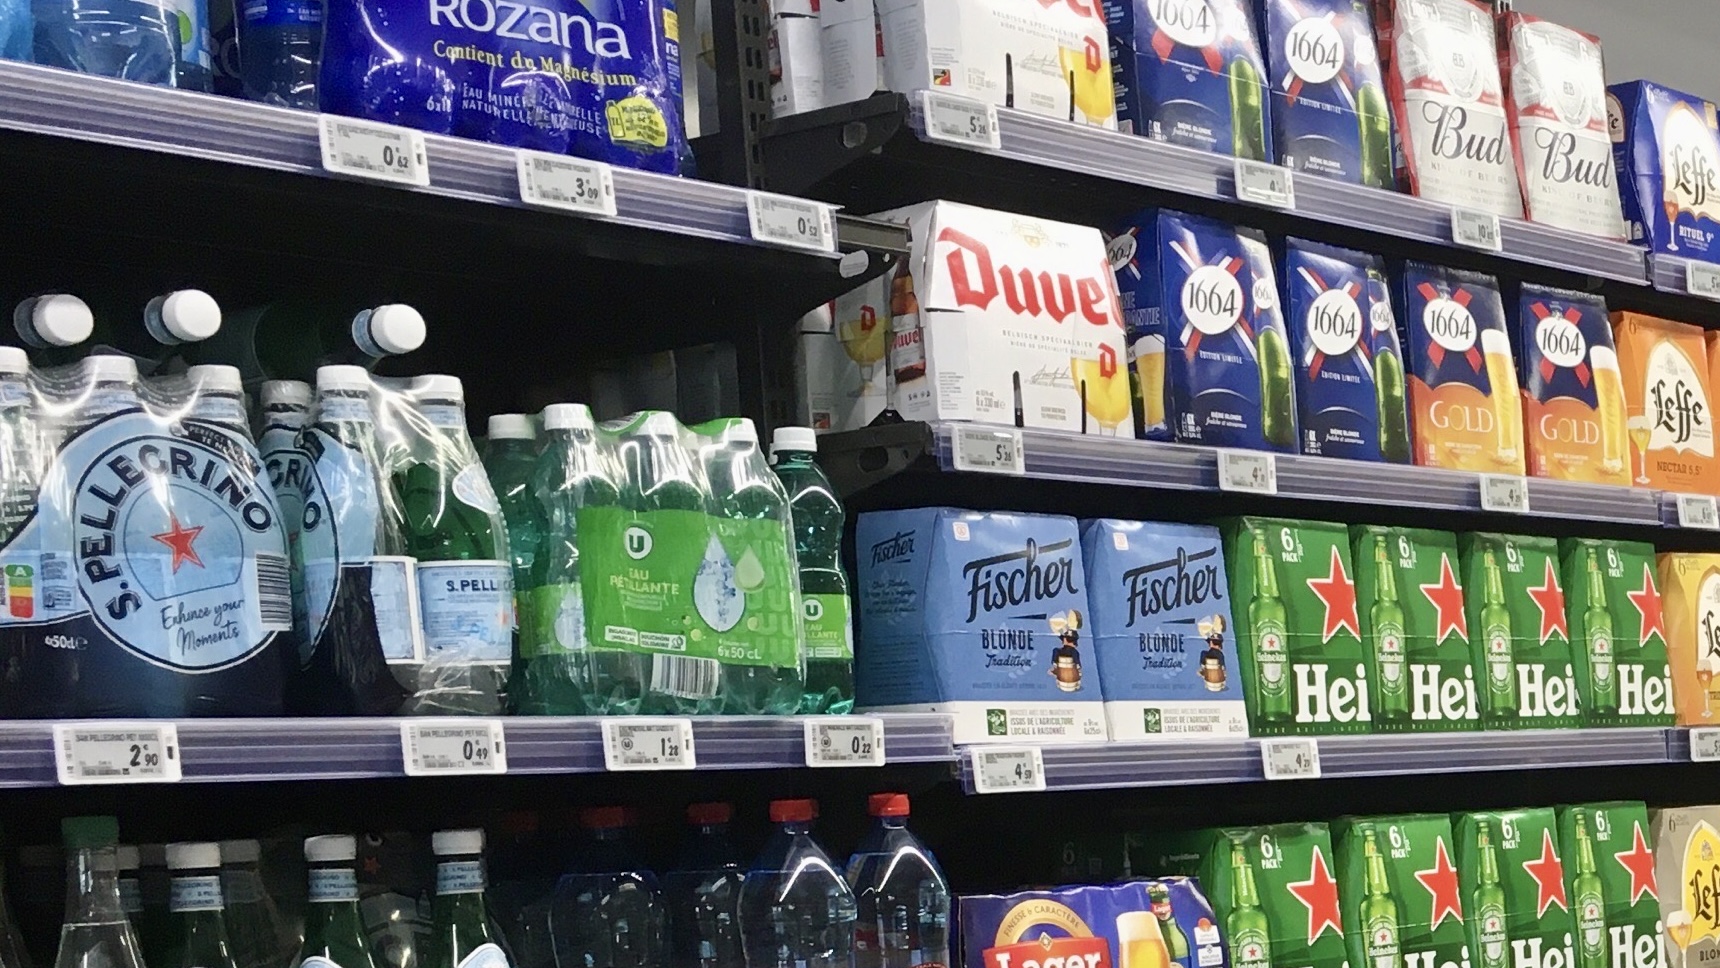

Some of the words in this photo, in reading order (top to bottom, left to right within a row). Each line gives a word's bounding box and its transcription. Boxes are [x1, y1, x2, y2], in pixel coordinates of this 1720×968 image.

[433, 40, 504, 66] Contient
[511, 50, 535, 71] du
[540, 56, 637, 86] Magnésium
[1291, 31, 1341, 71] 1664
[1423, 99, 1510, 167] Bud
[1535, 126, 1613, 189] Bud
[1186, 280, 1236, 318] 1664
[1313, 303, 1358, 339] 1664
[1429, 310, 1472, 341] 1664
[1541, 327, 1582, 356] 1664
[1429, 400, 1495, 433] GOLD
[1540, 413, 1600, 445] GOLD
[1650, 379, 1704, 443] Leffe
[1657, 459, 1686, 474] NECTAR
[80, 444, 272, 622] S.PELLEGRINO
[1280, 527, 1294, 551] 6
[963, 537, 1079, 624] Fischer
[1122, 546, 1224, 628] Fischer
[176, 622, 240, 656] Moments
[982, 629, 1035, 652] BLONDE
[1138, 632, 1185, 654] BLONDE
